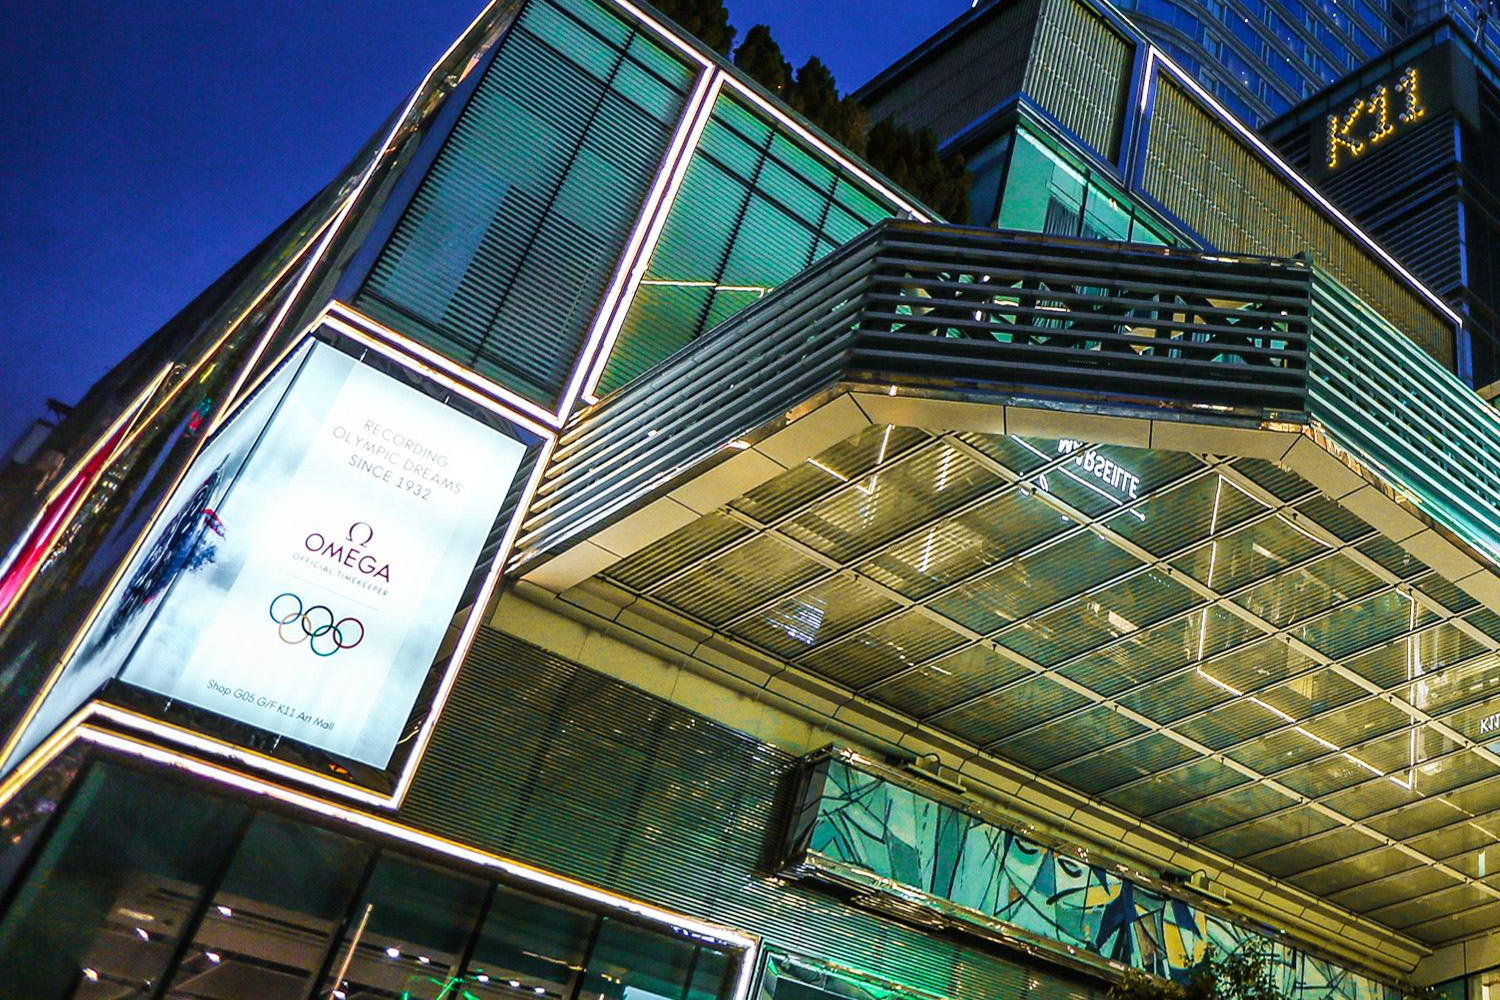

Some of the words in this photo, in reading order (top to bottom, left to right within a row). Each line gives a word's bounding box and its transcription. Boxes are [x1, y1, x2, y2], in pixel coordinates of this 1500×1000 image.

[1326, 66, 1424, 168] K11
[332, 426, 401, 465] OLYMPIC
[402, 459, 462, 495] DREAMS
[363, 419, 449, 468] RECORDING
[348, 453, 393, 483] SINCE
[395, 477, 432, 501] 1932
[292, 552, 333, 576] OFFICIAL
[337, 570, 390, 597] TIMEKEEPER
[305, 532, 390, 584] OMEGA
[206, 679, 232, 697] Shop
[233, 688, 256, 704] G05
[256, 696, 278, 710] G/F
[277, 703, 297, 718] K11
[297, 711, 314, 724] Art
[312, 717, 336, 732] Mall
